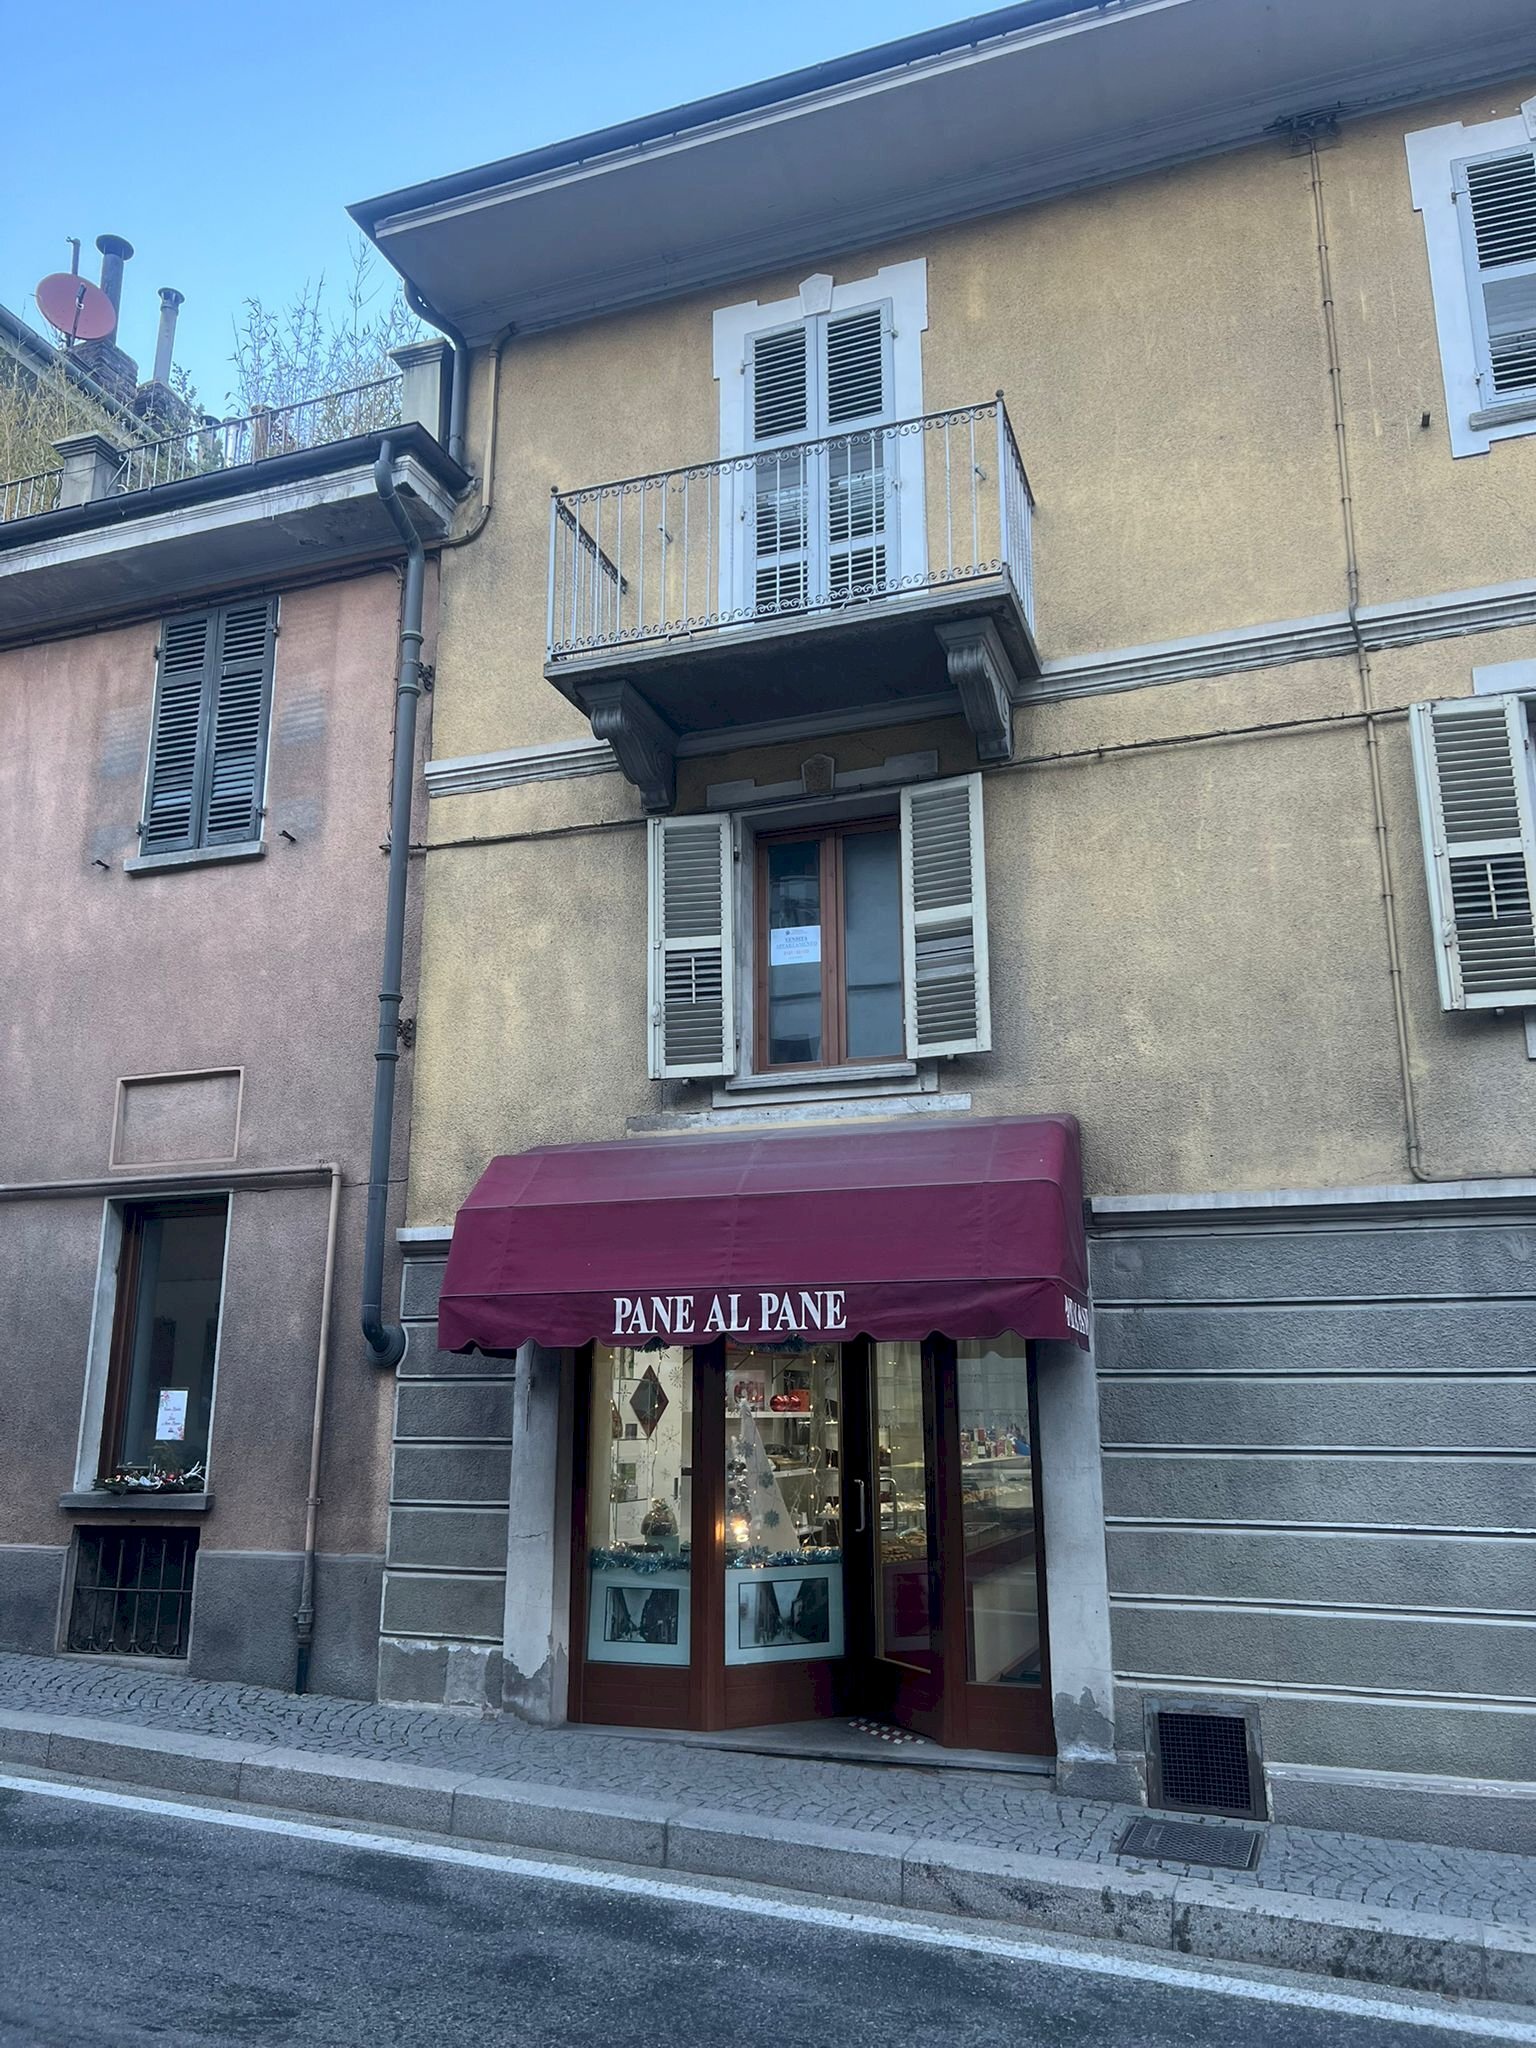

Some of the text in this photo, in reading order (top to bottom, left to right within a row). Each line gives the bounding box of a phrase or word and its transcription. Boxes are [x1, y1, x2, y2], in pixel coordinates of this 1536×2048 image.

[612, 1290, 847, 1335] PANE AL PANE
